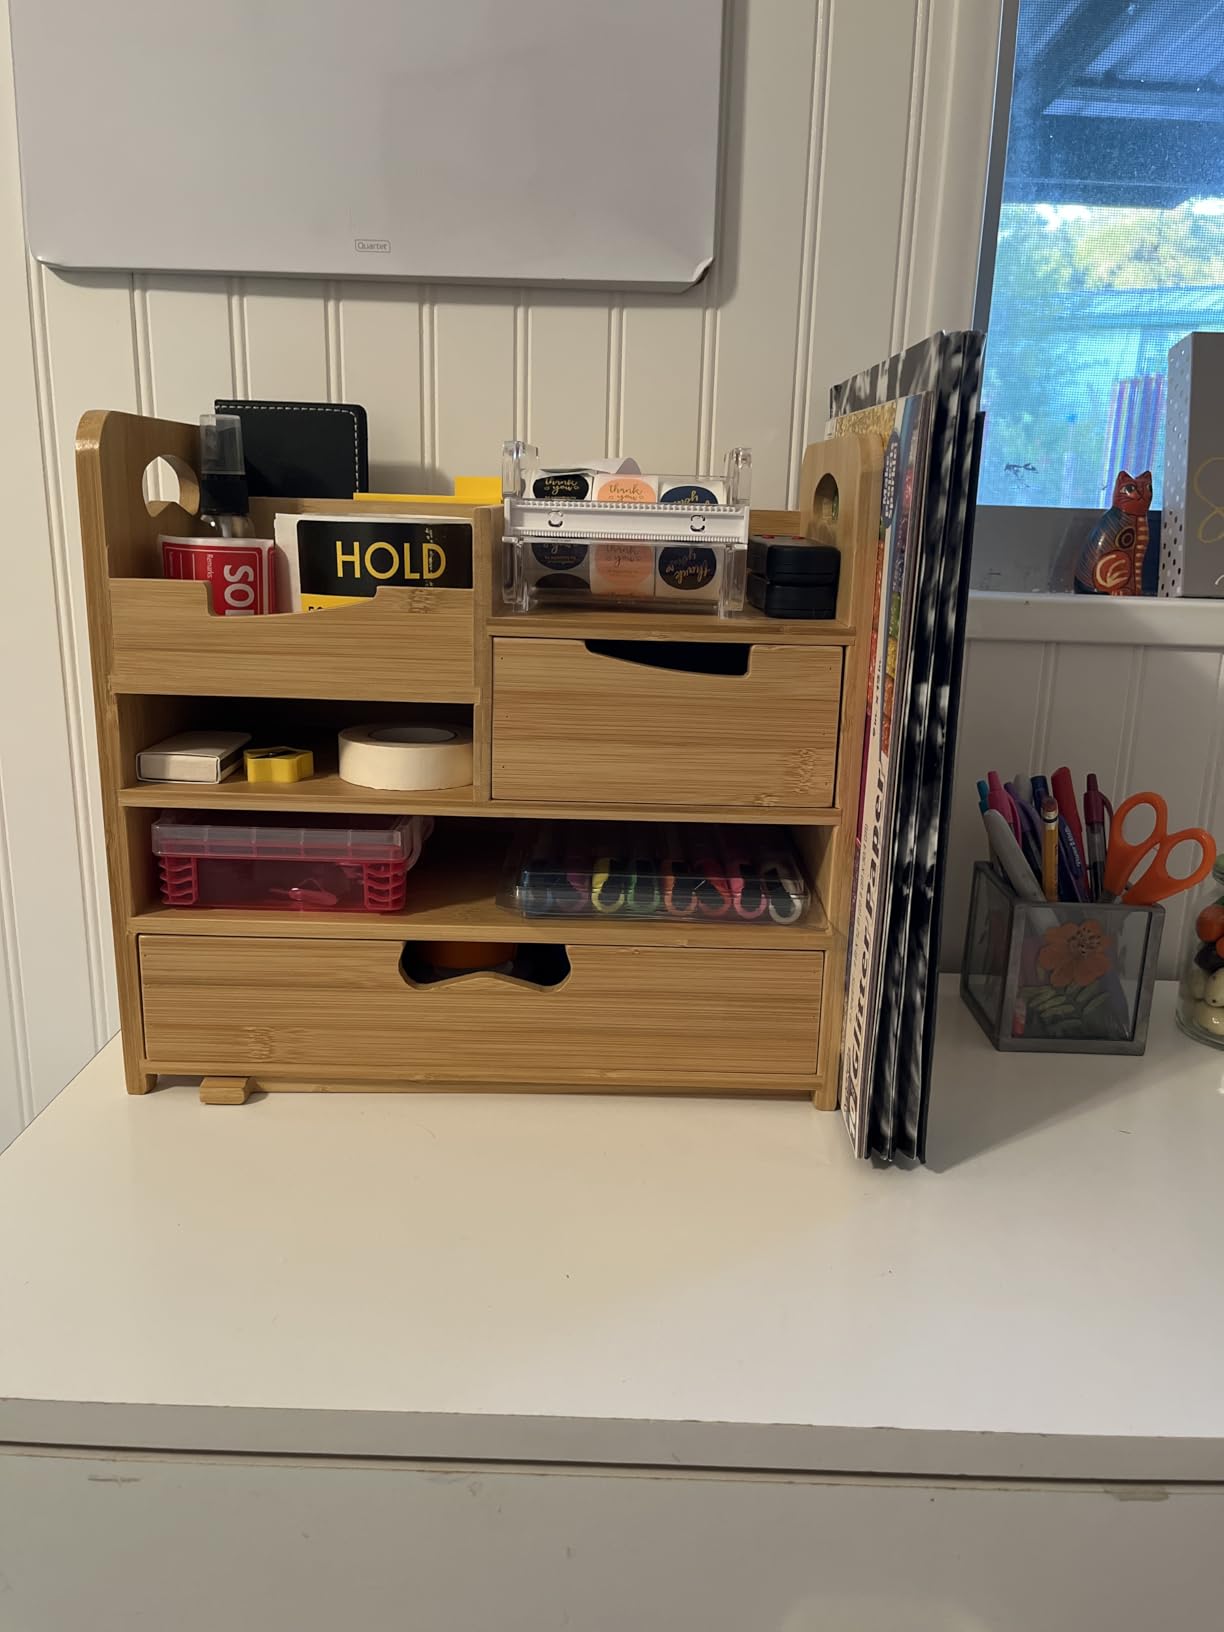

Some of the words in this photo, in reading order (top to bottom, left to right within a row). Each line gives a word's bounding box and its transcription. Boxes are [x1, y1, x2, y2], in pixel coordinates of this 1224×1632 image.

[357, 242, 388, 250] Quartet
[336, 541, 446, 579] HOLD
[851, 925, 870, 1080] Glitter
[866, 767, 884, 920] Paper
